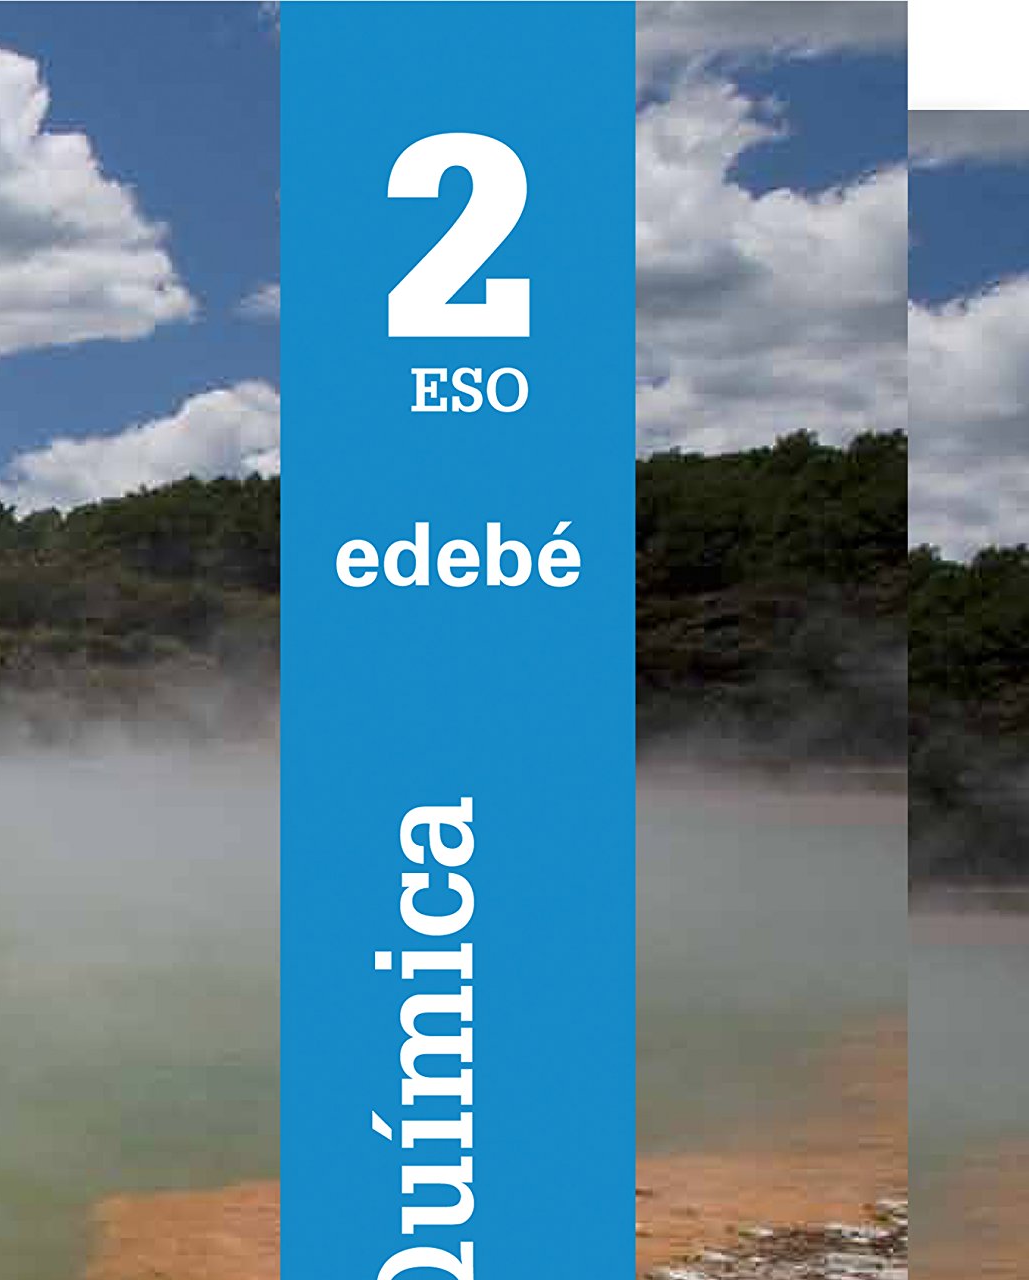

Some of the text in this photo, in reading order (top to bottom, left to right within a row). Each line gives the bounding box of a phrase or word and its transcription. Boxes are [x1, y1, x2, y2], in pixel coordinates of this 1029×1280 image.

[388, 133, 530, 337] 2
[411, 368, 528, 412] ESO
[336, 521, 580, 587] edebé
